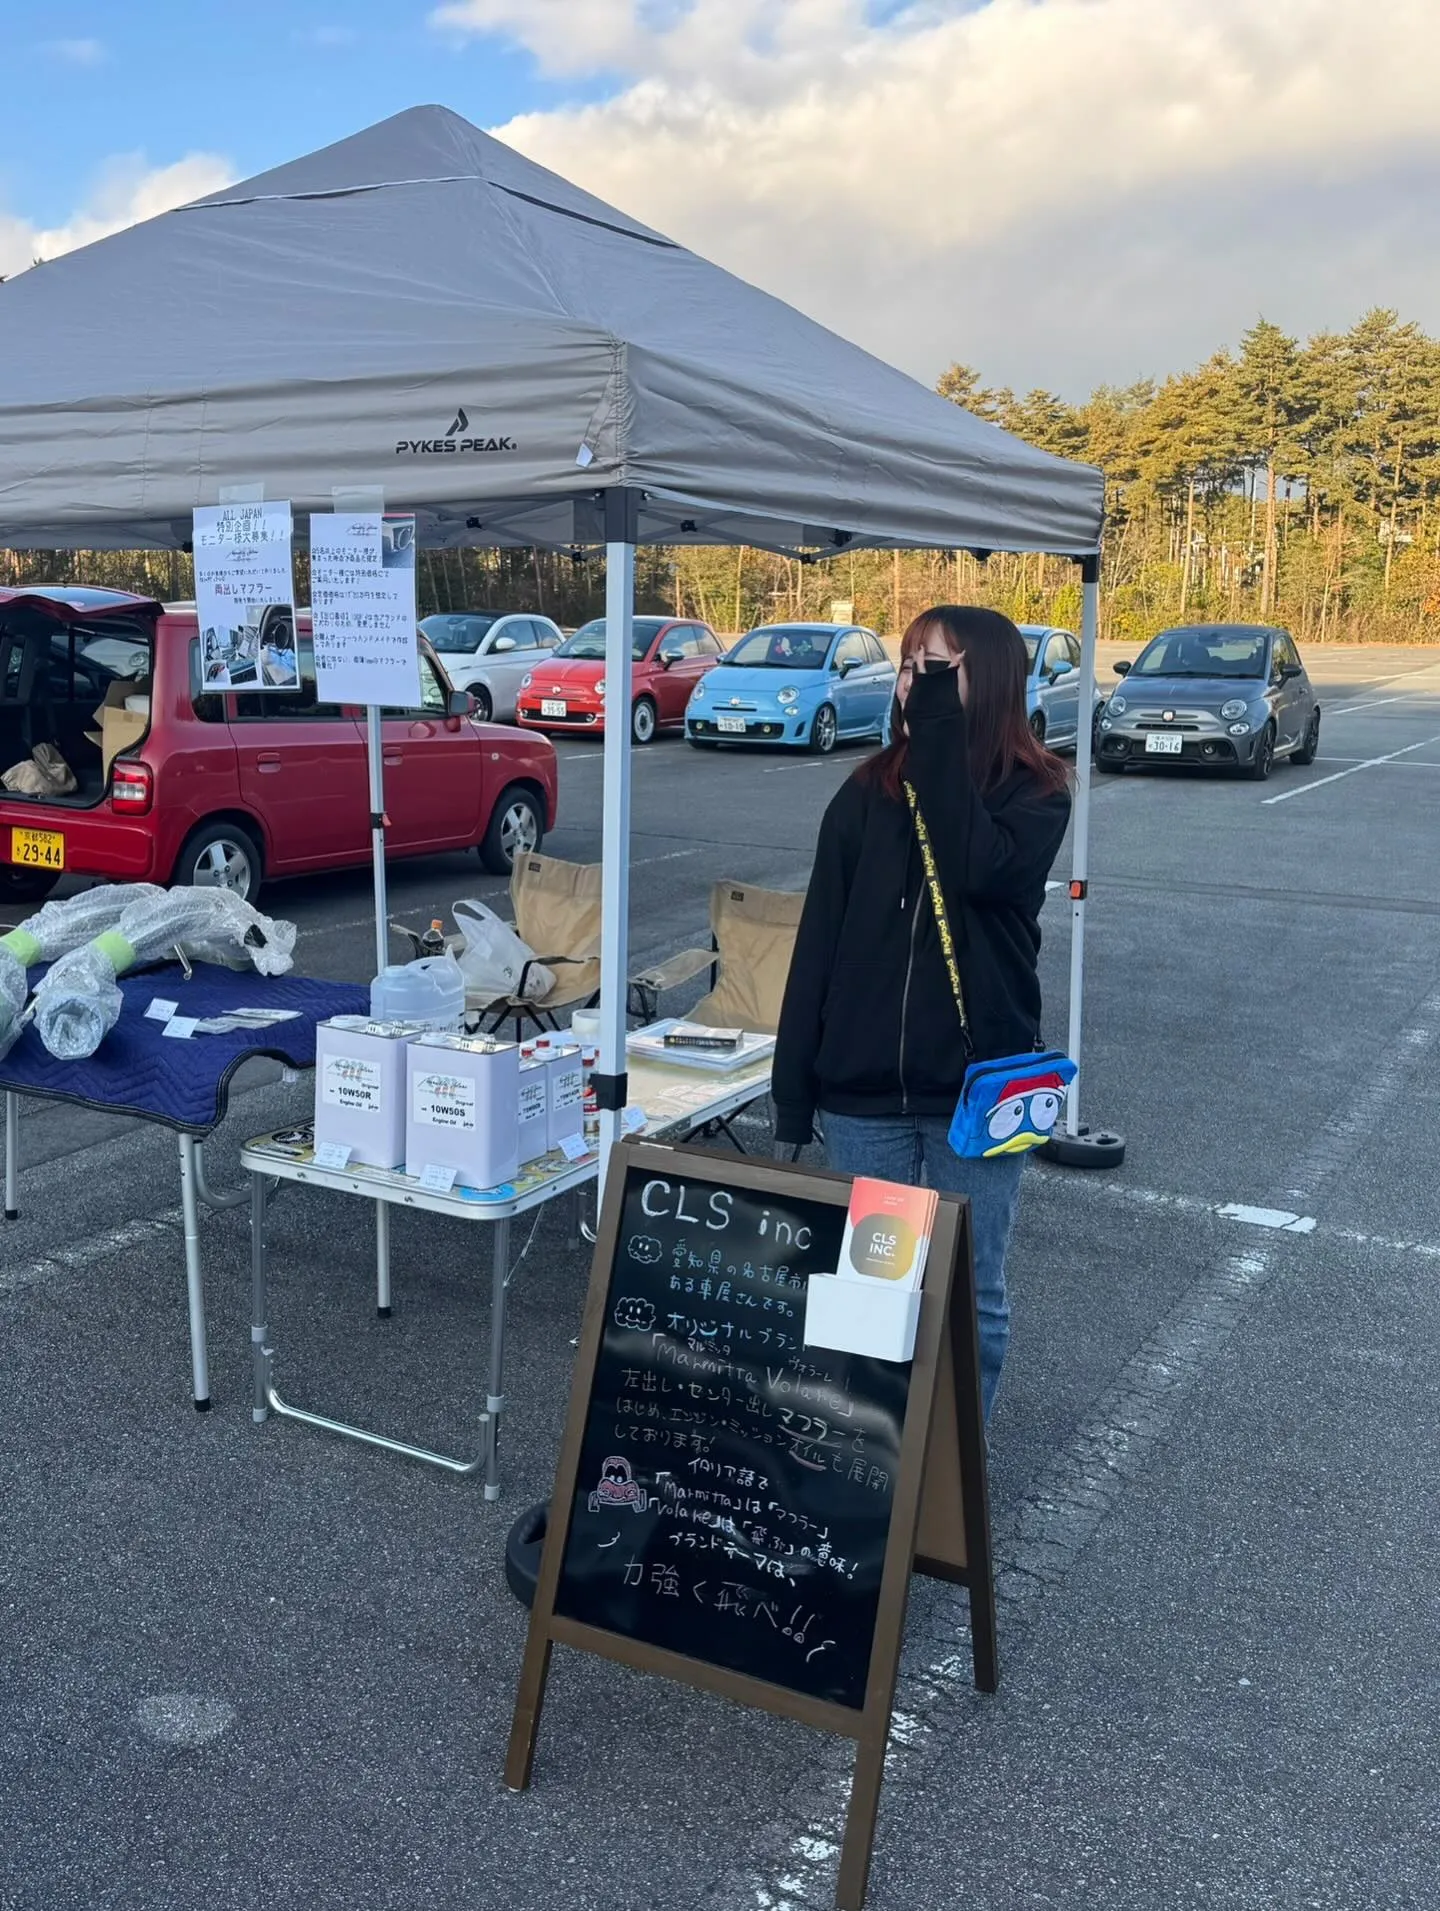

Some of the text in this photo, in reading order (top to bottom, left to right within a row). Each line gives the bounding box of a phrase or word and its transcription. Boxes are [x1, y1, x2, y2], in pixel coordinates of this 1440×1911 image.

[396, 437, 511, 454] PYKES PEAK
[223, 507, 262, 521] ALL JAPAN
[215, 583, 272, 596] 両出しマフラー
[23, 842, 61, 867] 29-44
[338, 1087, 372, 1100] 10W50R
[431, 1104, 466, 1117] 10W50S
[641, 1179, 813, 1251] CLS inc
[872, 1232, 897, 1246] CLS
[869, 1243, 896, 1257] INC.
[669, 1274, 794, 1318] ある車屋さんです。
[687, 1457, 769, 1490] イタリア語で
